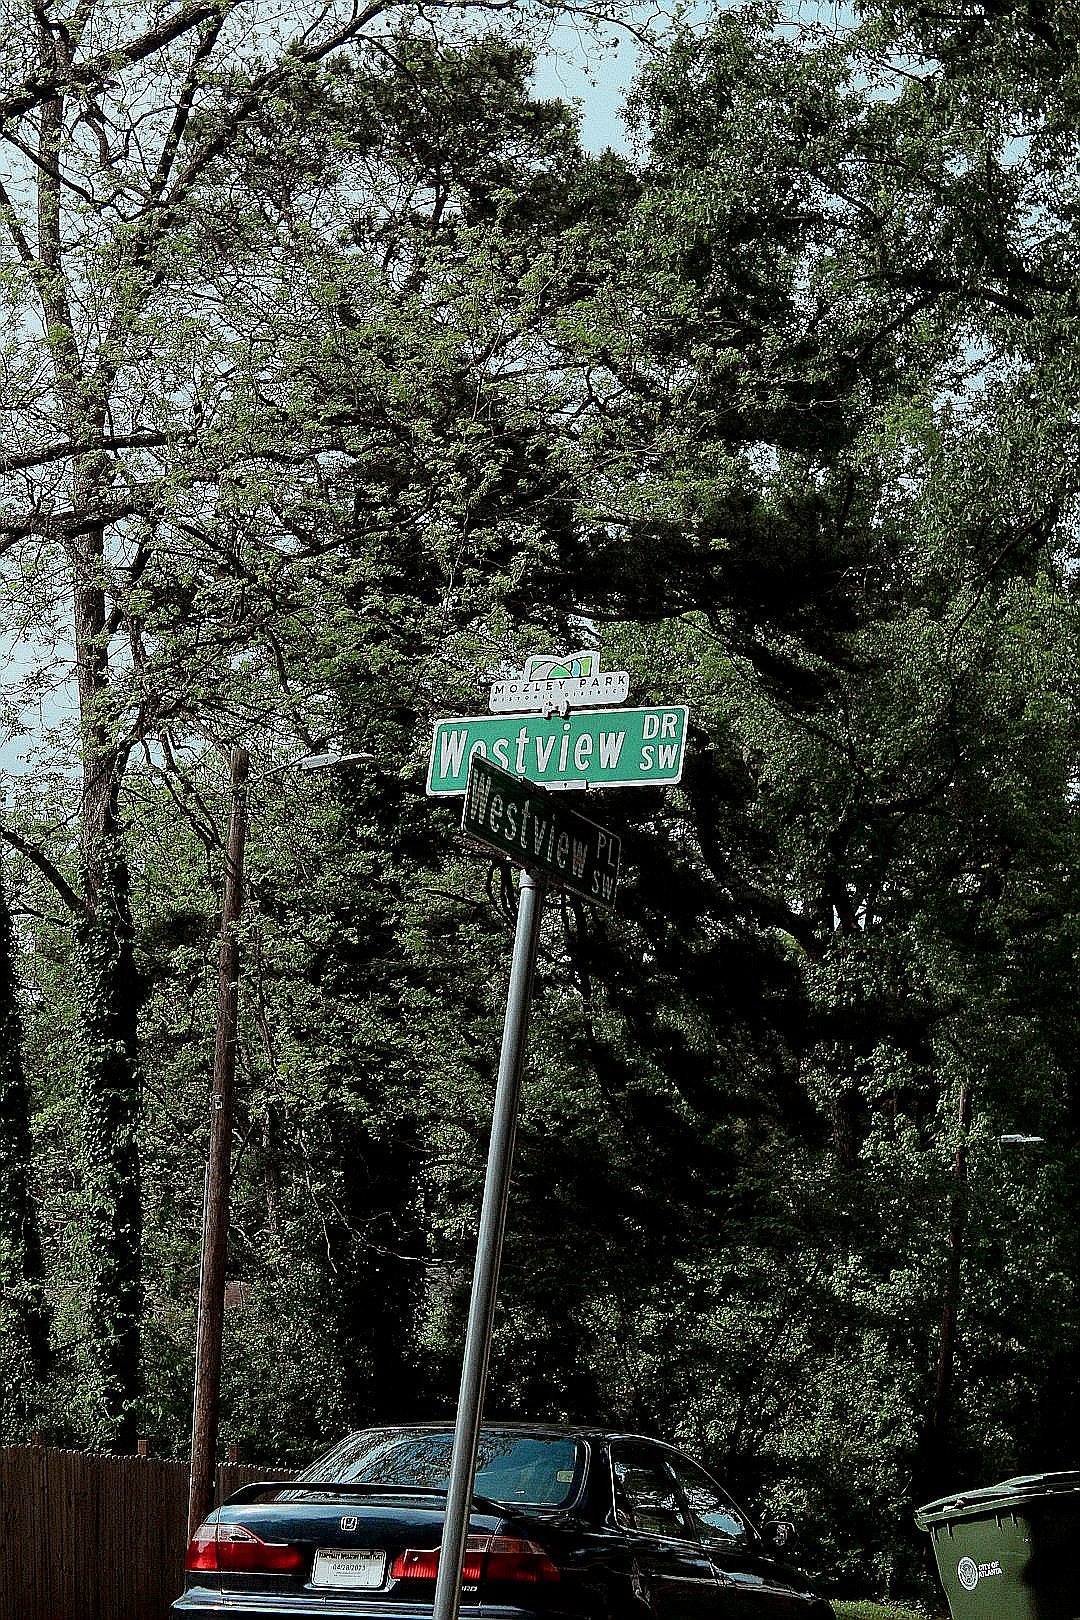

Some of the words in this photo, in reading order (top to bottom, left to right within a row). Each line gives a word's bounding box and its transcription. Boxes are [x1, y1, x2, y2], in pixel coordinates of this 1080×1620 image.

[494, 681, 566, 695] MOZLEY
[579, 675, 626, 688] PARK
[642, 713, 679, 740] DR
[639, 743, 680, 771] SW
[469, 768, 589, 879] Westview
[596, 831, 616, 868] PL
[591, 869, 615, 900] SW
[978, 1562, 991, 1571] CITY
[991, 1561, 1000, 1569] OF
[978, 1567, 1003, 1578] ATLANTA
